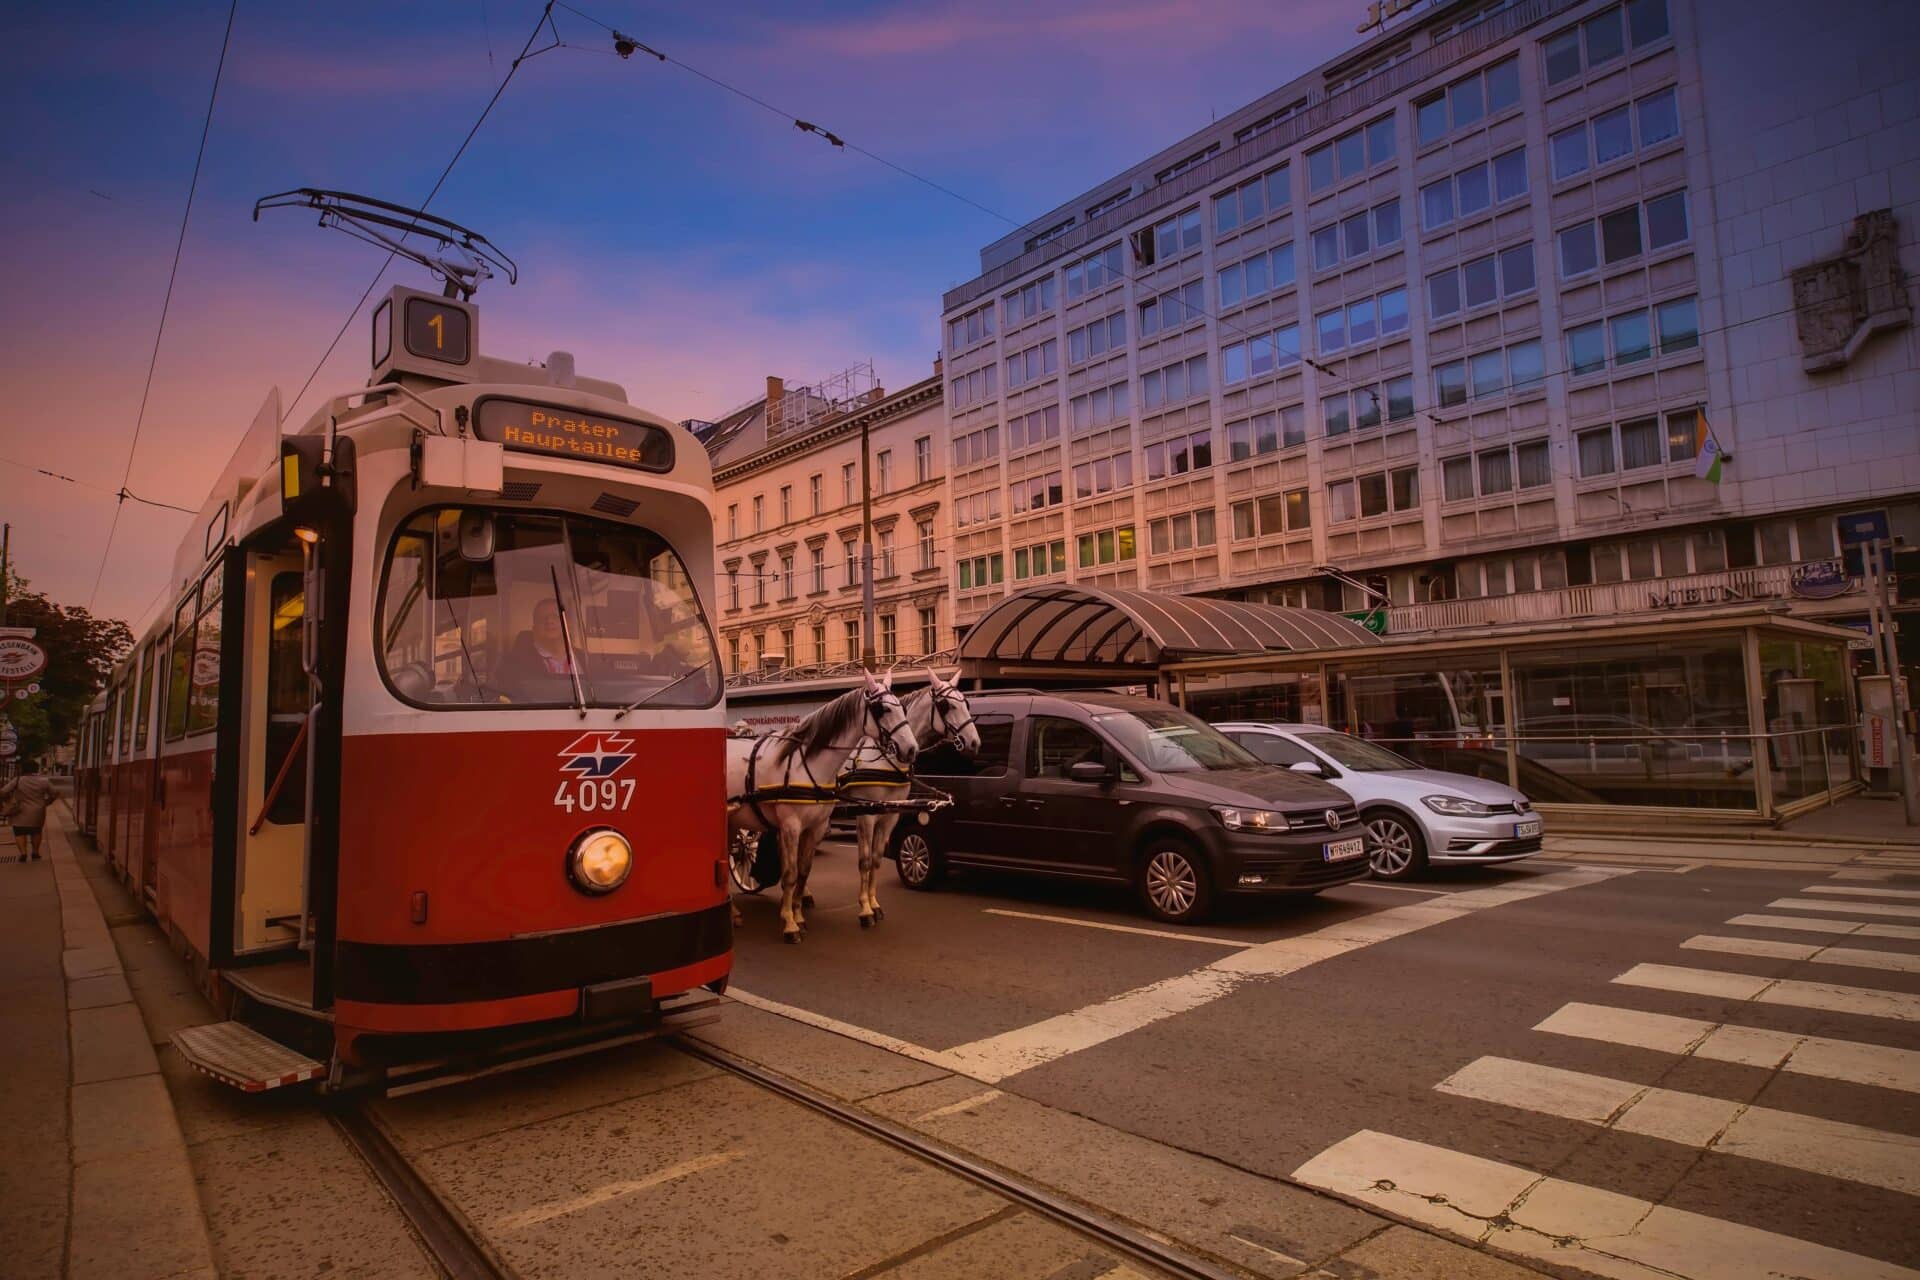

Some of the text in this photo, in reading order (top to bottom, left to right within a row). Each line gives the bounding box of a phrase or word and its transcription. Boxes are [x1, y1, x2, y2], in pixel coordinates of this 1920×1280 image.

[427, 313, 445, 351] 1
[531, 410, 620, 439] Prater
[504, 425, 642, 463] Hauptallee
[553, 779, 637, 814] 4097
